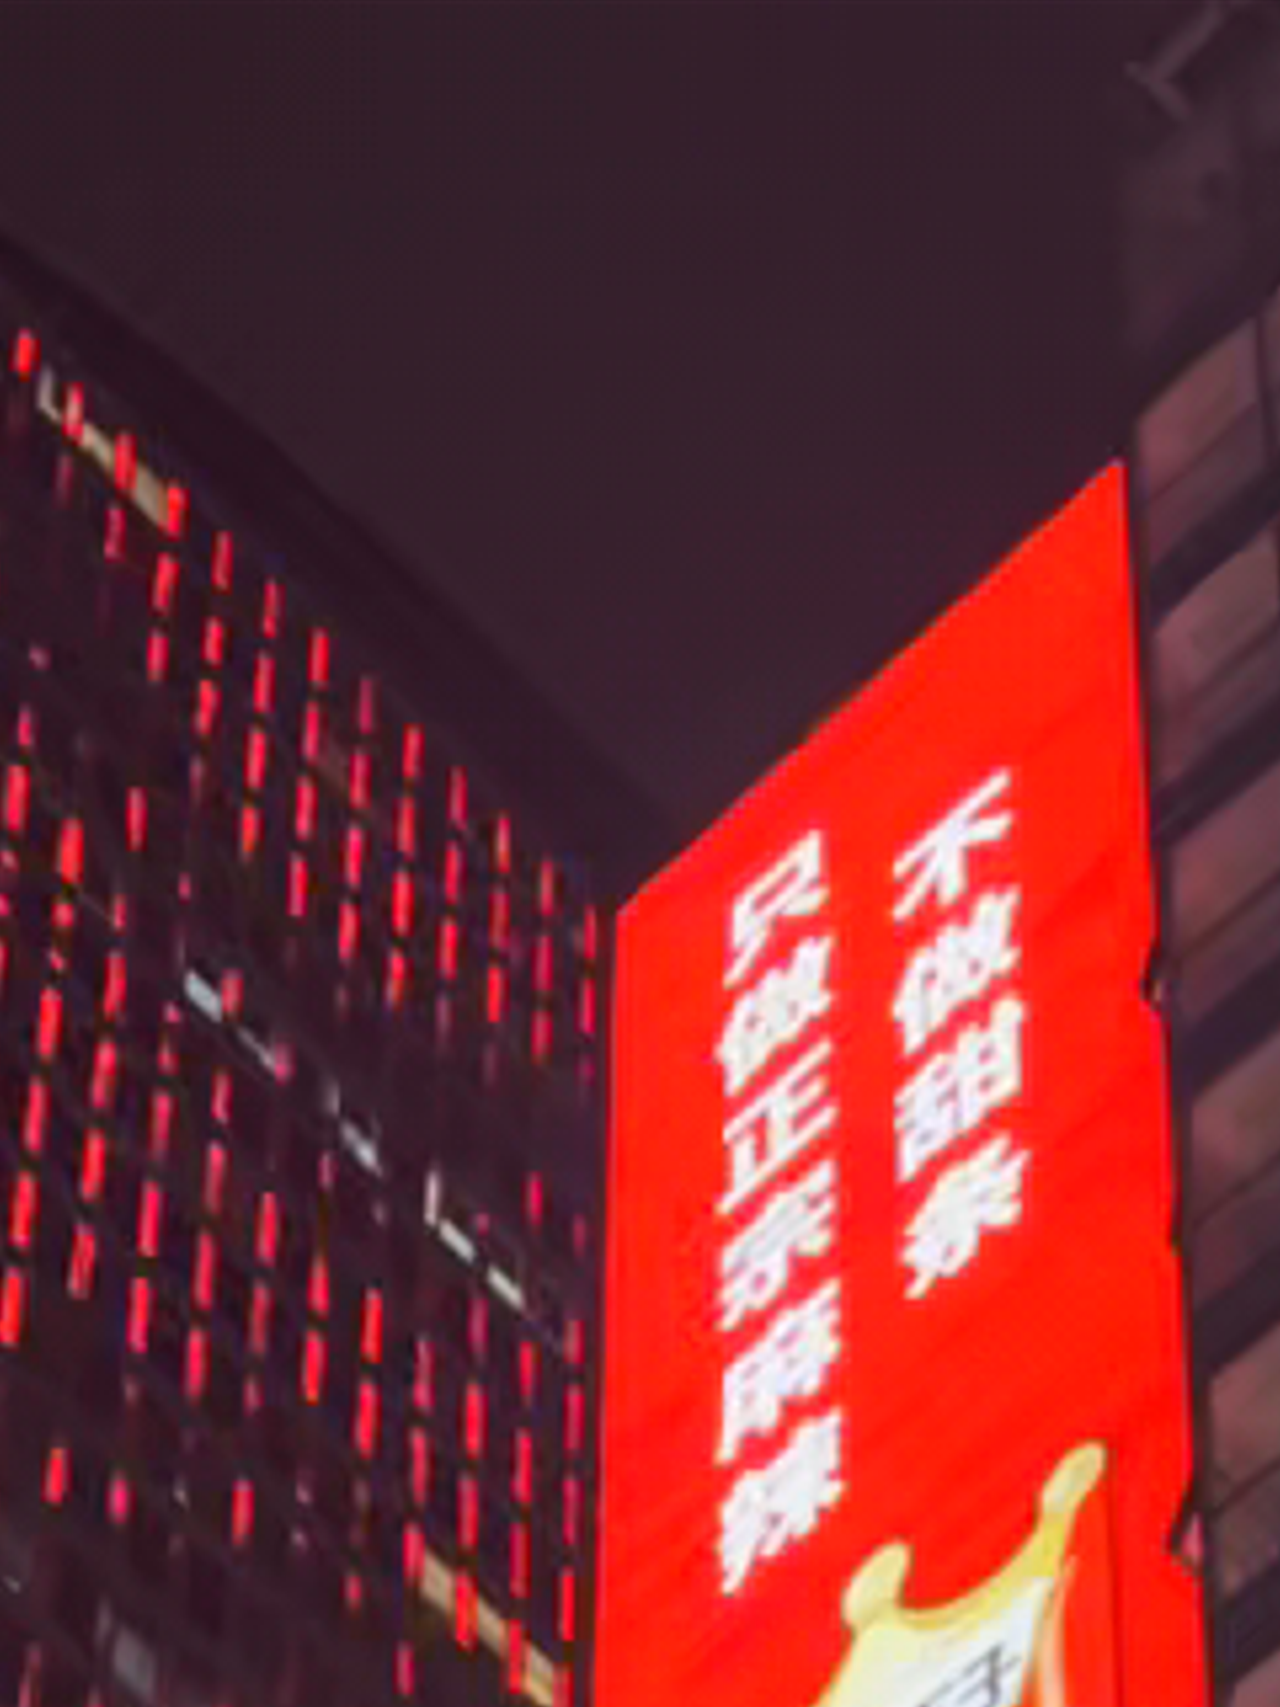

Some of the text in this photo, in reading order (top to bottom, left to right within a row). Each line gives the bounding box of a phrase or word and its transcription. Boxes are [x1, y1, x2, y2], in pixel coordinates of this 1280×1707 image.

[716, 828, 847, 1598] 只做正宗麻辣
